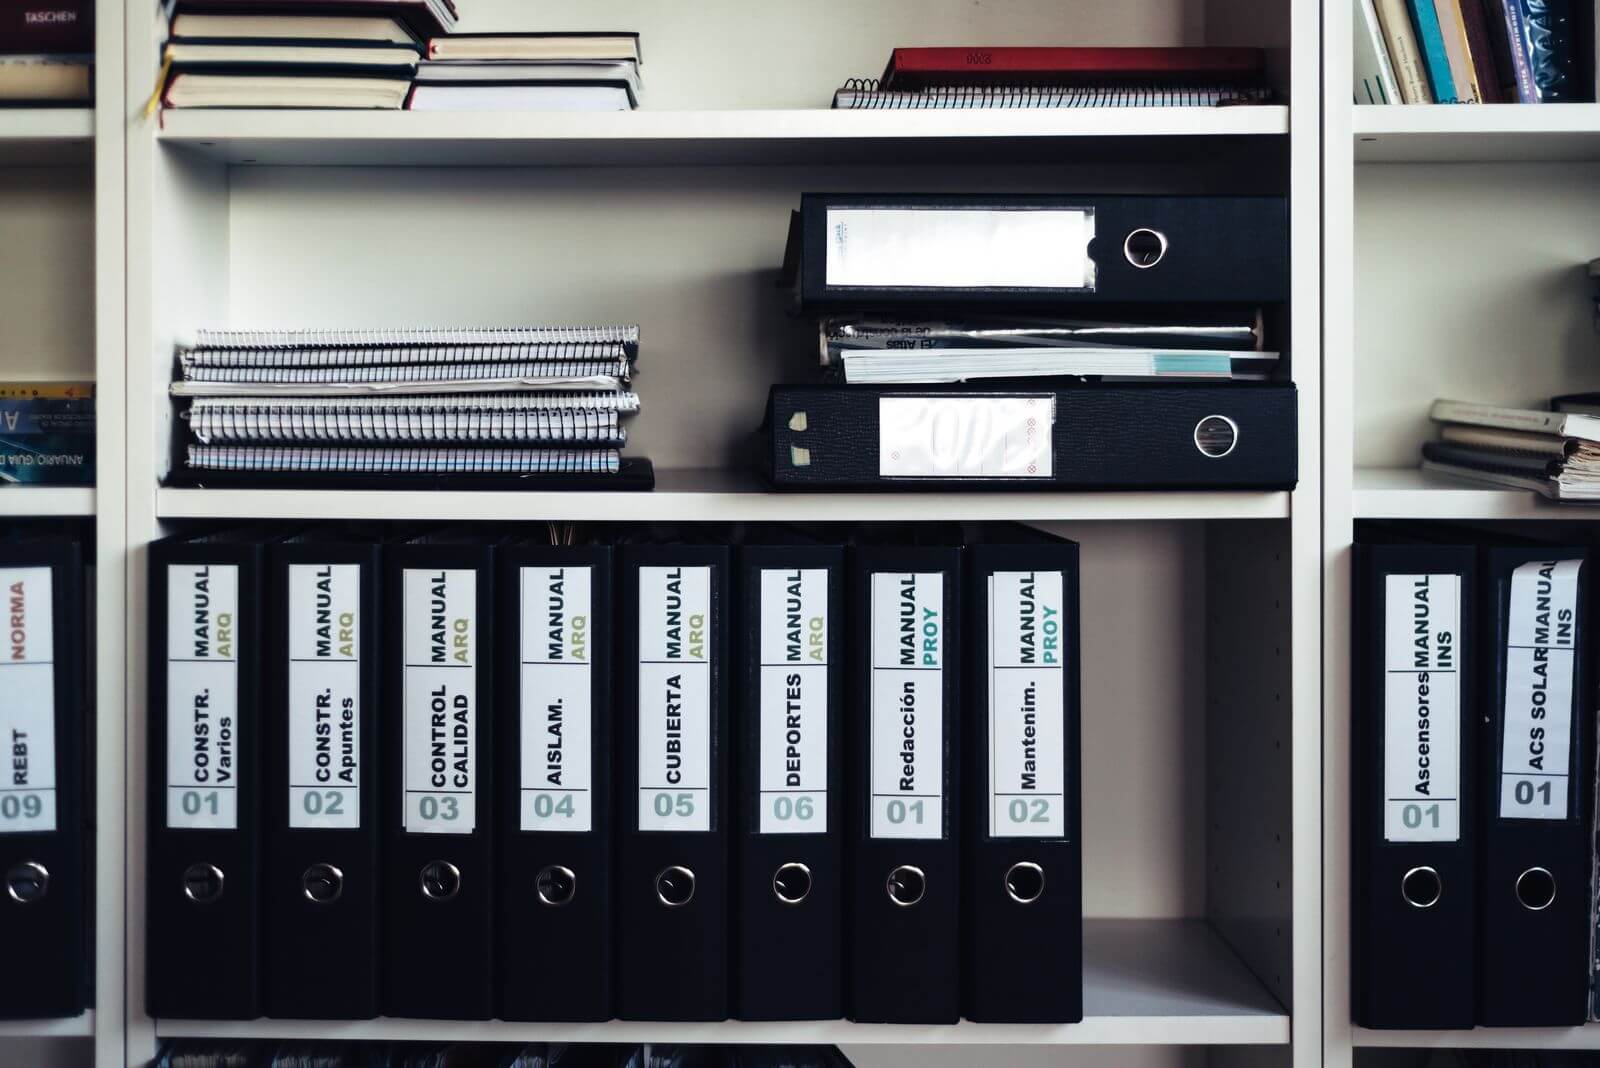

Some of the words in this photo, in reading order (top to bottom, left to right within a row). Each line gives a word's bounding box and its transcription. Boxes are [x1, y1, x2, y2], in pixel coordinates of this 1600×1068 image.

[24, 11, 77, 23] TASCHEN
[10, 581, 25, 660] NORMA
[194, 566, 209, 657] MANUAL
[316, 566, 331, 657] MANUAL
[432, 571, 446, 662] MANUAL
[549, 568, 564, 660] MANUAL
[666, 567, 681, 659] MANUAL
[786, 570, 801, 661] MANUAL
[900, 573, 915, 665] MANUAL
[1020, 572, 1035, 664] MANUAL
[1414, 575, 1429, 668] MANUAL
[1534, 560, 1558, 644] MANUAL
[1556, 608, 1572, 645] INS
[217, 613, 233, 657] ARQ
[339, 613, 354, 657] ARQ
[454, 619, 469, 663] ARQ
[571, 615, 586, 660] ARQ
[689, 614, 704, 658] ARQ
[809, 617, 824, 661] ARQ
[923, 607, 938, 666] PROY
[1043, 606, 1058, 663] PROY
[1437, 631, 1452, 668] INS
[1531, 648, 1549, 720] SOLAR
[12, 729, 28, 785] REBT
[194, 688, 209, 783] CONSTR.
[217, 716, 232, 783] Varios
[316, 688, 331, 783] CONSTR.
[338, 697, 356, 783] Apuntes
[431, 685, 446, 788] CONTROL
[453, 694, 468, 788] CALIDAD
[547, 698, 562, 786] AISLAM.
[666, 674, 681, 784] CUBIERTA
[786, 673, 801, 787] DEPORTES
[900, 681, 915, 791] Redacción
[1020, 681, 1036, 790] Mantenim.
[1415, 672, 1430, 796] Ascensores
[1529, 727, 1545, 770] ACS
[1, 794, 42, 819] 09
[182, 791, 219, 815] 01
[303, 791, 344, 815] 02
[419, 796, 459, 821] 03
[534, 794, 575, 818] 04
[654, 793, 694, 817] 05
[773, 796, 814, 821] 06
[887, 800, 924, 824] 01
[1009, 799, 1050, 823] 02
[1402, 804, 1440, 828] 01
[1515, 780, 1551, 805] 01
